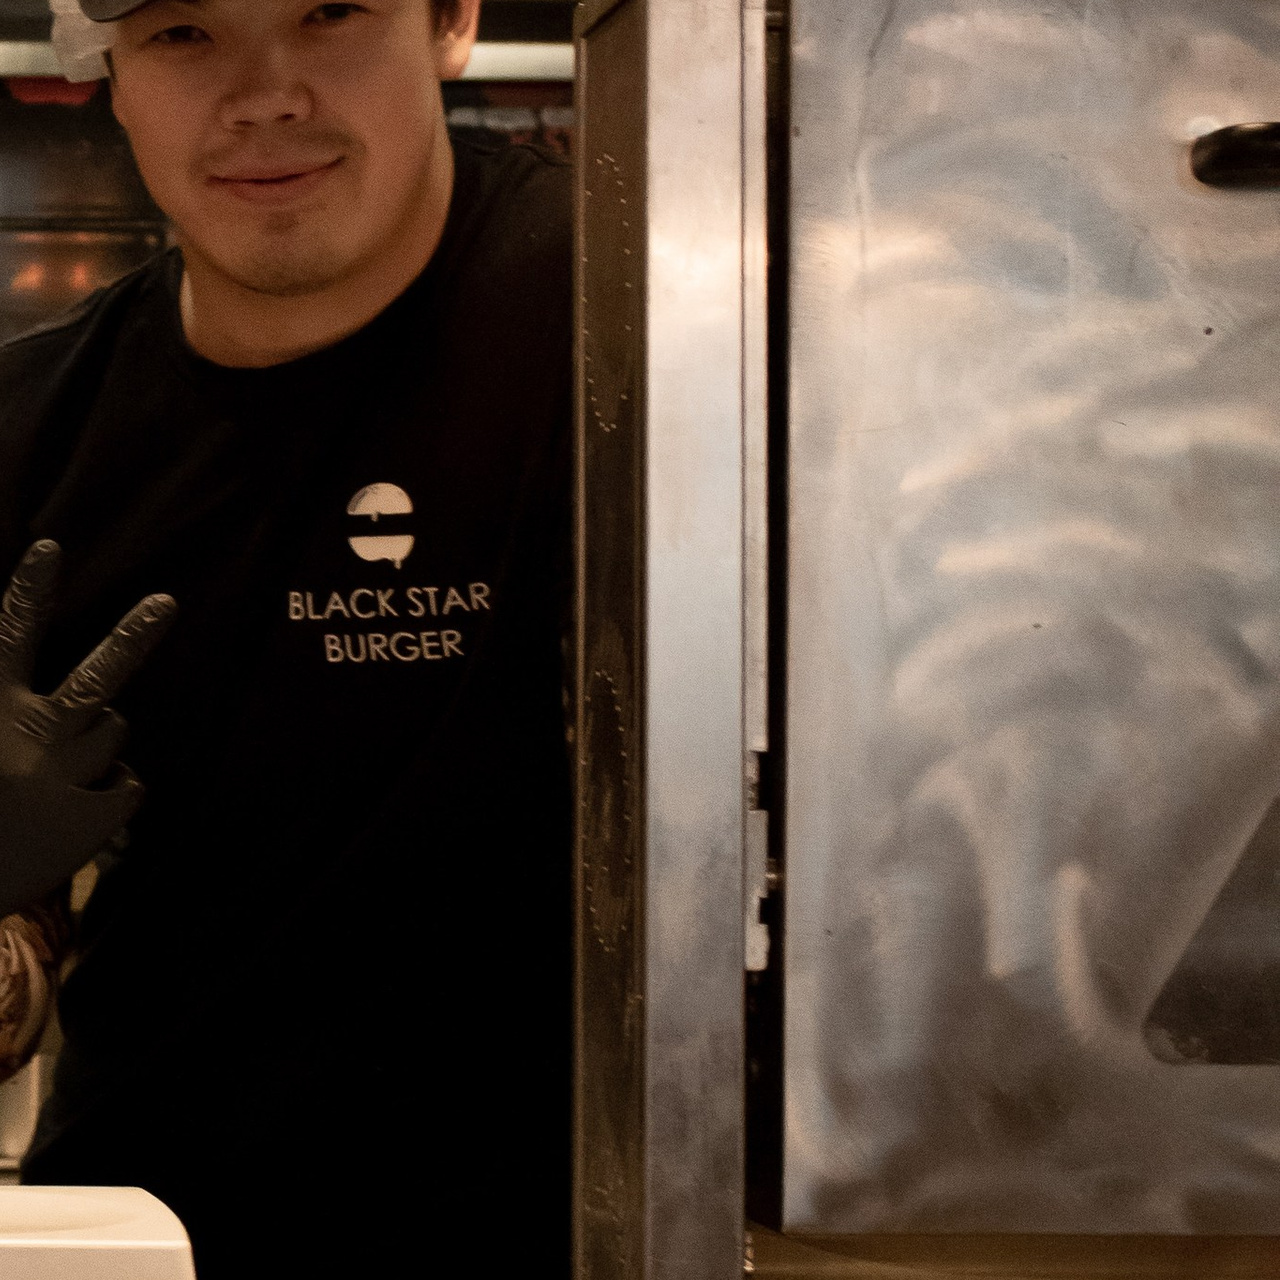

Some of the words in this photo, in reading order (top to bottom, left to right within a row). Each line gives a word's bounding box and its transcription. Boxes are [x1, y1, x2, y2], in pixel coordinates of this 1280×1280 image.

[288, 588, 400, 620] BLACK
[406, 582, 491, 618] STAR
[324, 629, 465, 663] BURGER
